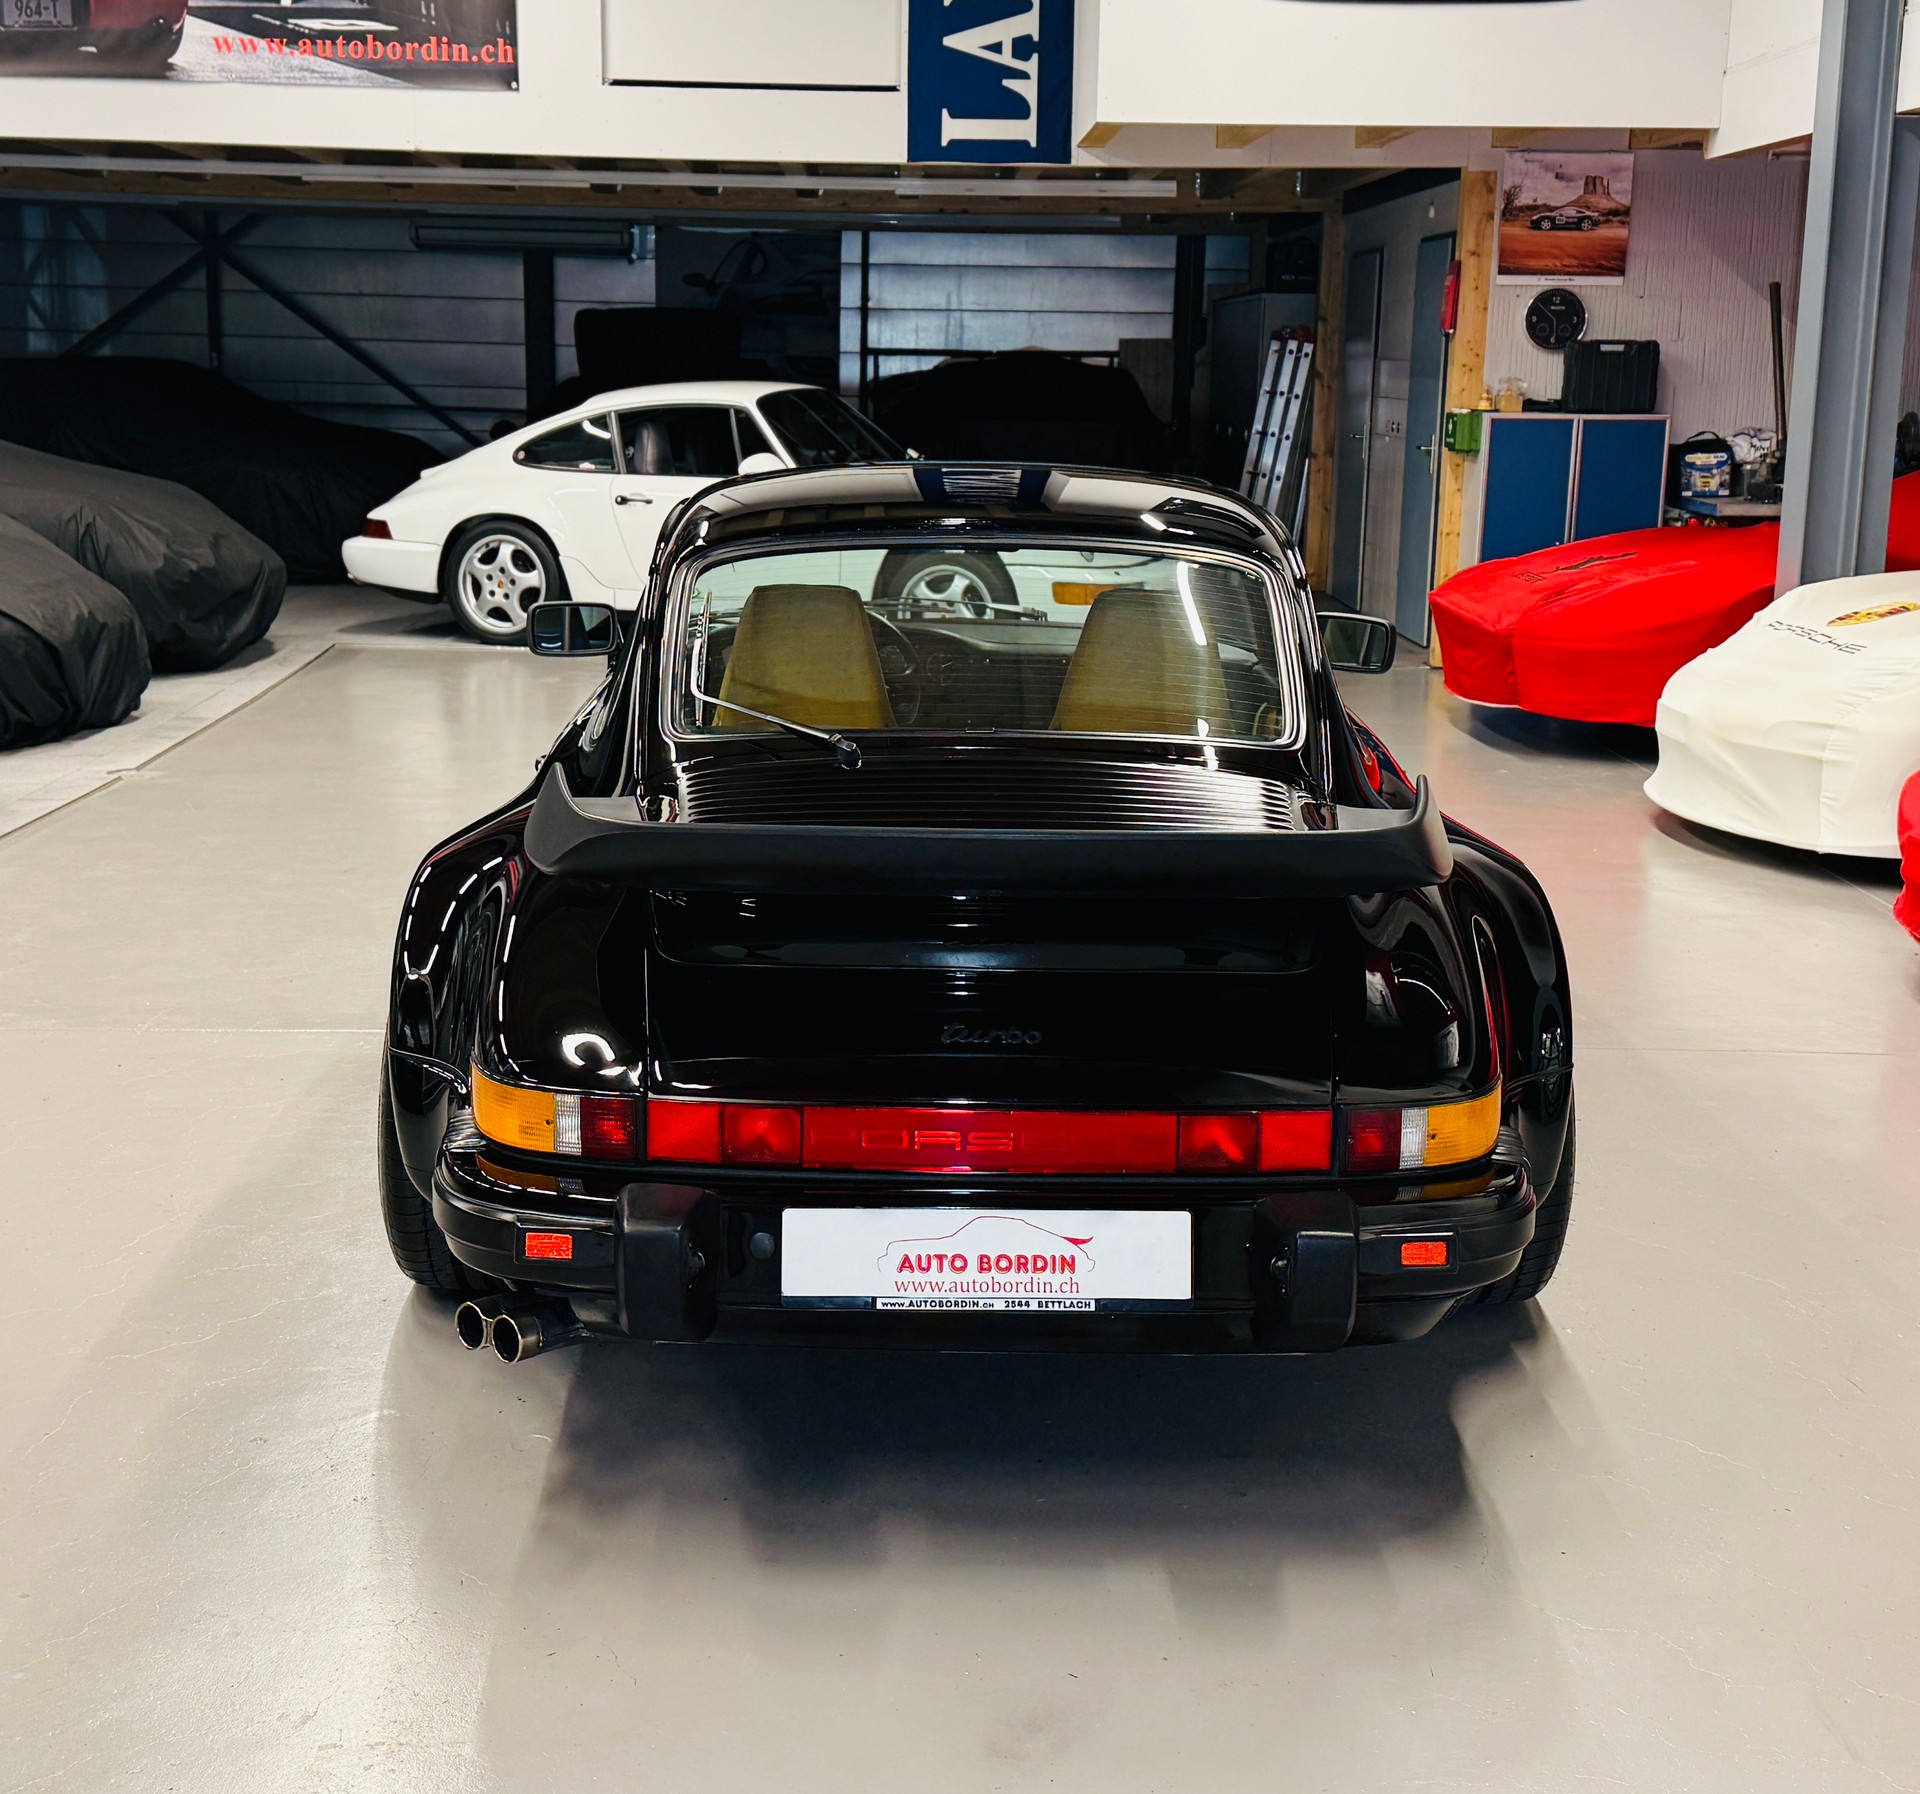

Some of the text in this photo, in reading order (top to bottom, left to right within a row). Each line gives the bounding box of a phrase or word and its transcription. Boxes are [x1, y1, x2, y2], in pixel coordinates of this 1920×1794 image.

[212, 34, 515, 64] www.autobordin.ch
[941, 0, 1040, 148] LA
[896, 1253, 1076, 1274] AUTO BORDIN
[894, 1276, 1080, 1294] www.autobordin.ch
[1004, 1300, 1031, 1309] 2544
[1037, 1300, 1092, 1310] BETTLACH
